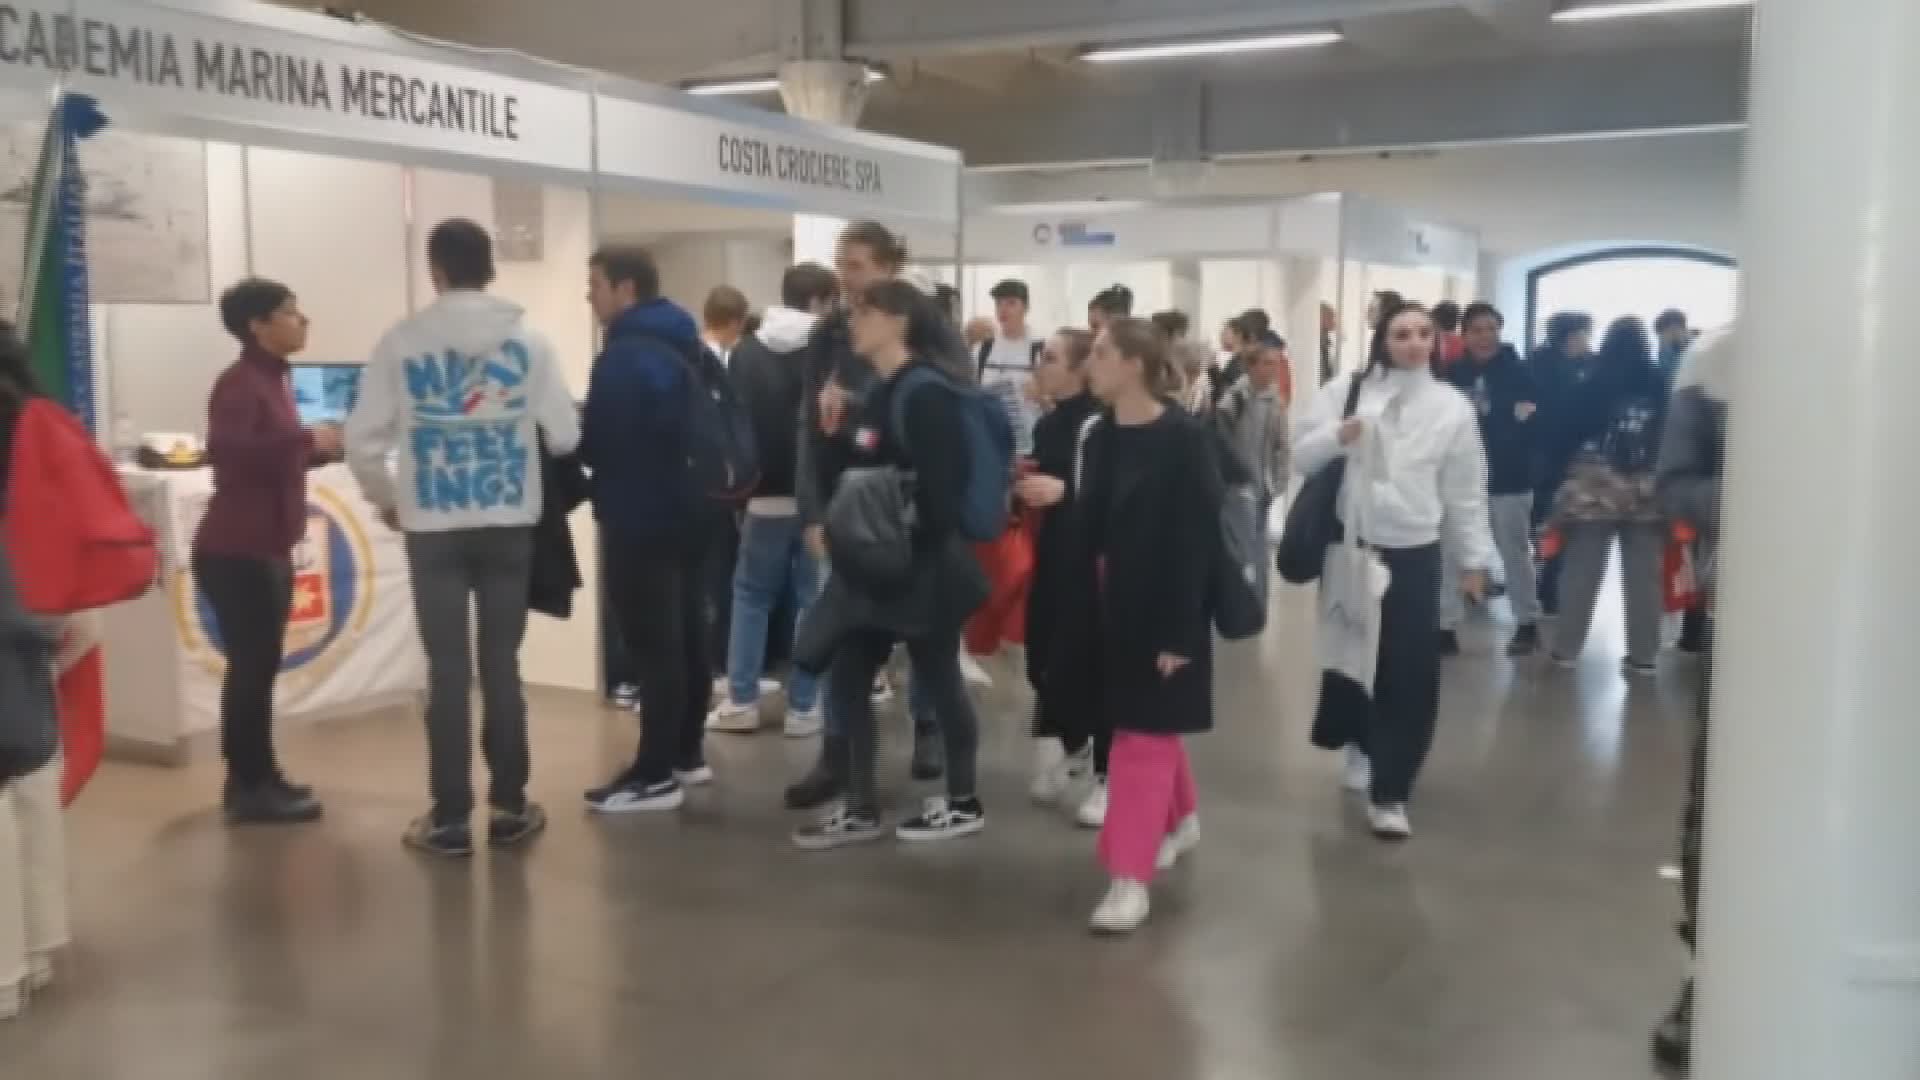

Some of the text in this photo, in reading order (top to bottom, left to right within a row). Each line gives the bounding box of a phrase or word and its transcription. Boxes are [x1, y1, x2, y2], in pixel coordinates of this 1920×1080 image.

[194, 40, 332, 111] MARINA
[343, 65, 518, 140] MERCANTILE
[719, 133, 882, 192] COSTA CROCIERE SPA
